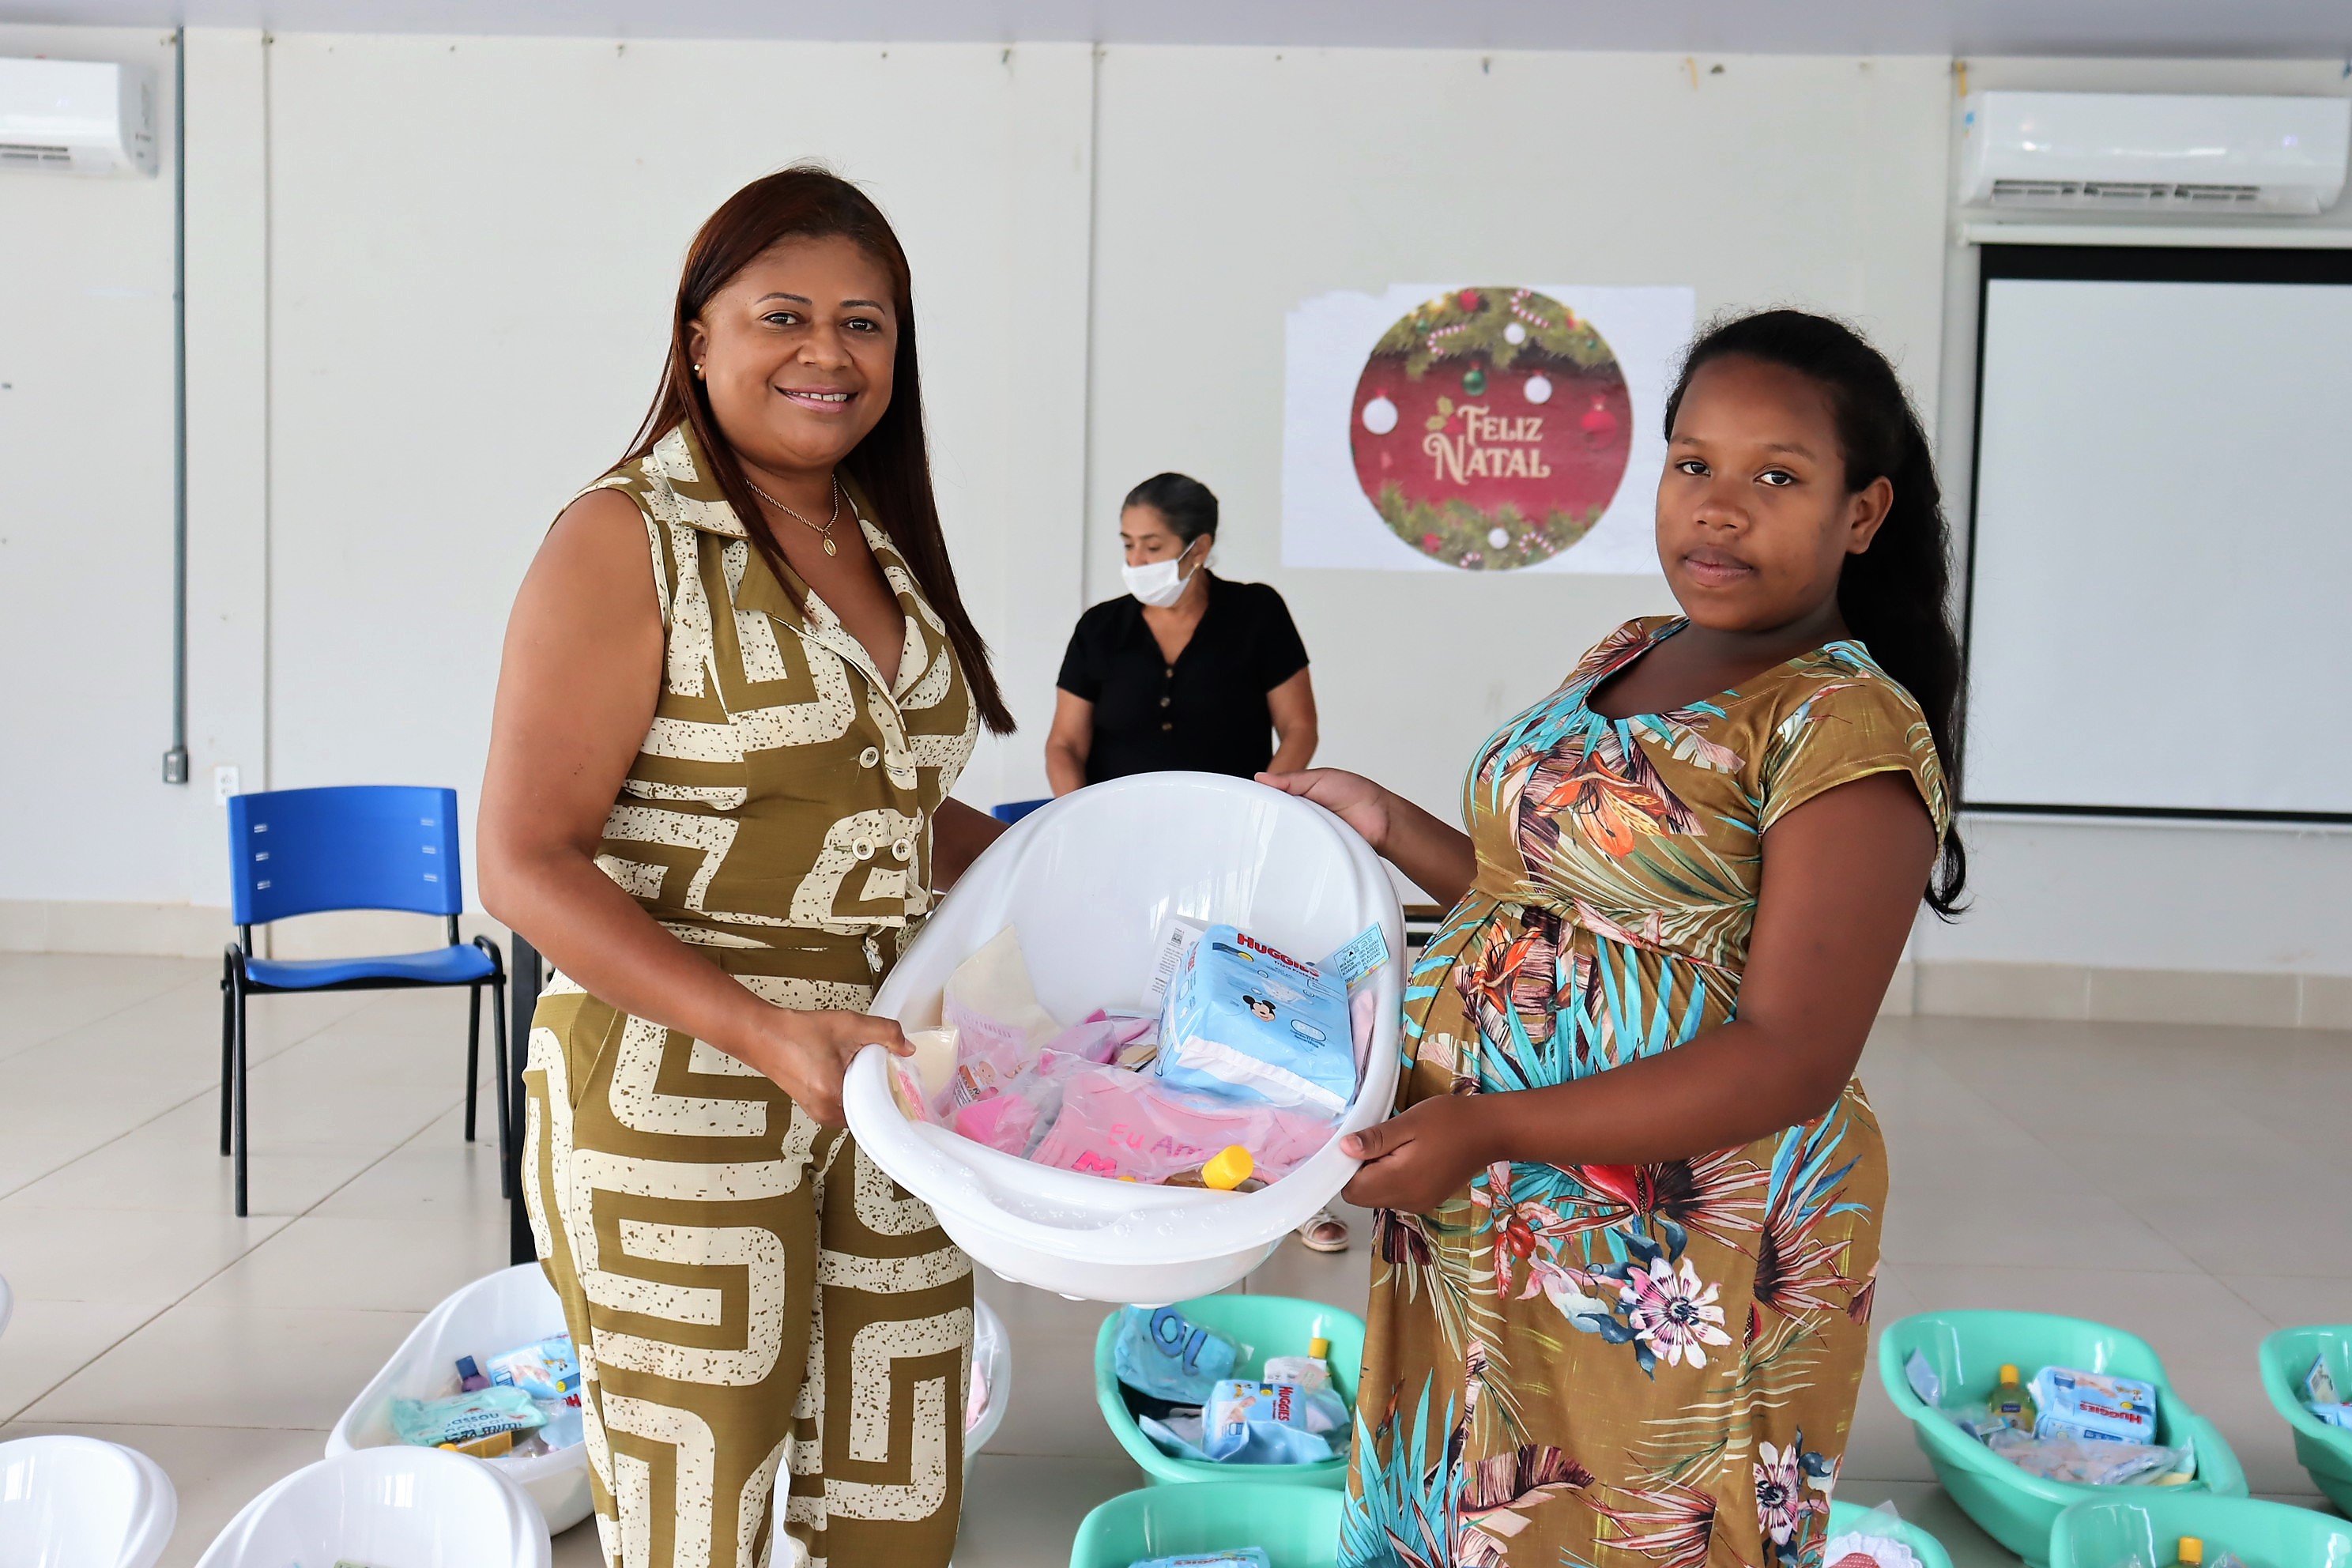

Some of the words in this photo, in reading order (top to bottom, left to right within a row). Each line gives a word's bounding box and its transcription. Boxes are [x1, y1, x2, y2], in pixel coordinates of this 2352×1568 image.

[1237, 933, 1320, 978] HUGGIES
[1278, 1385, 1294, 1421] HUGGIES
[2079, 1402, 2143, 1425] HUGGIES
